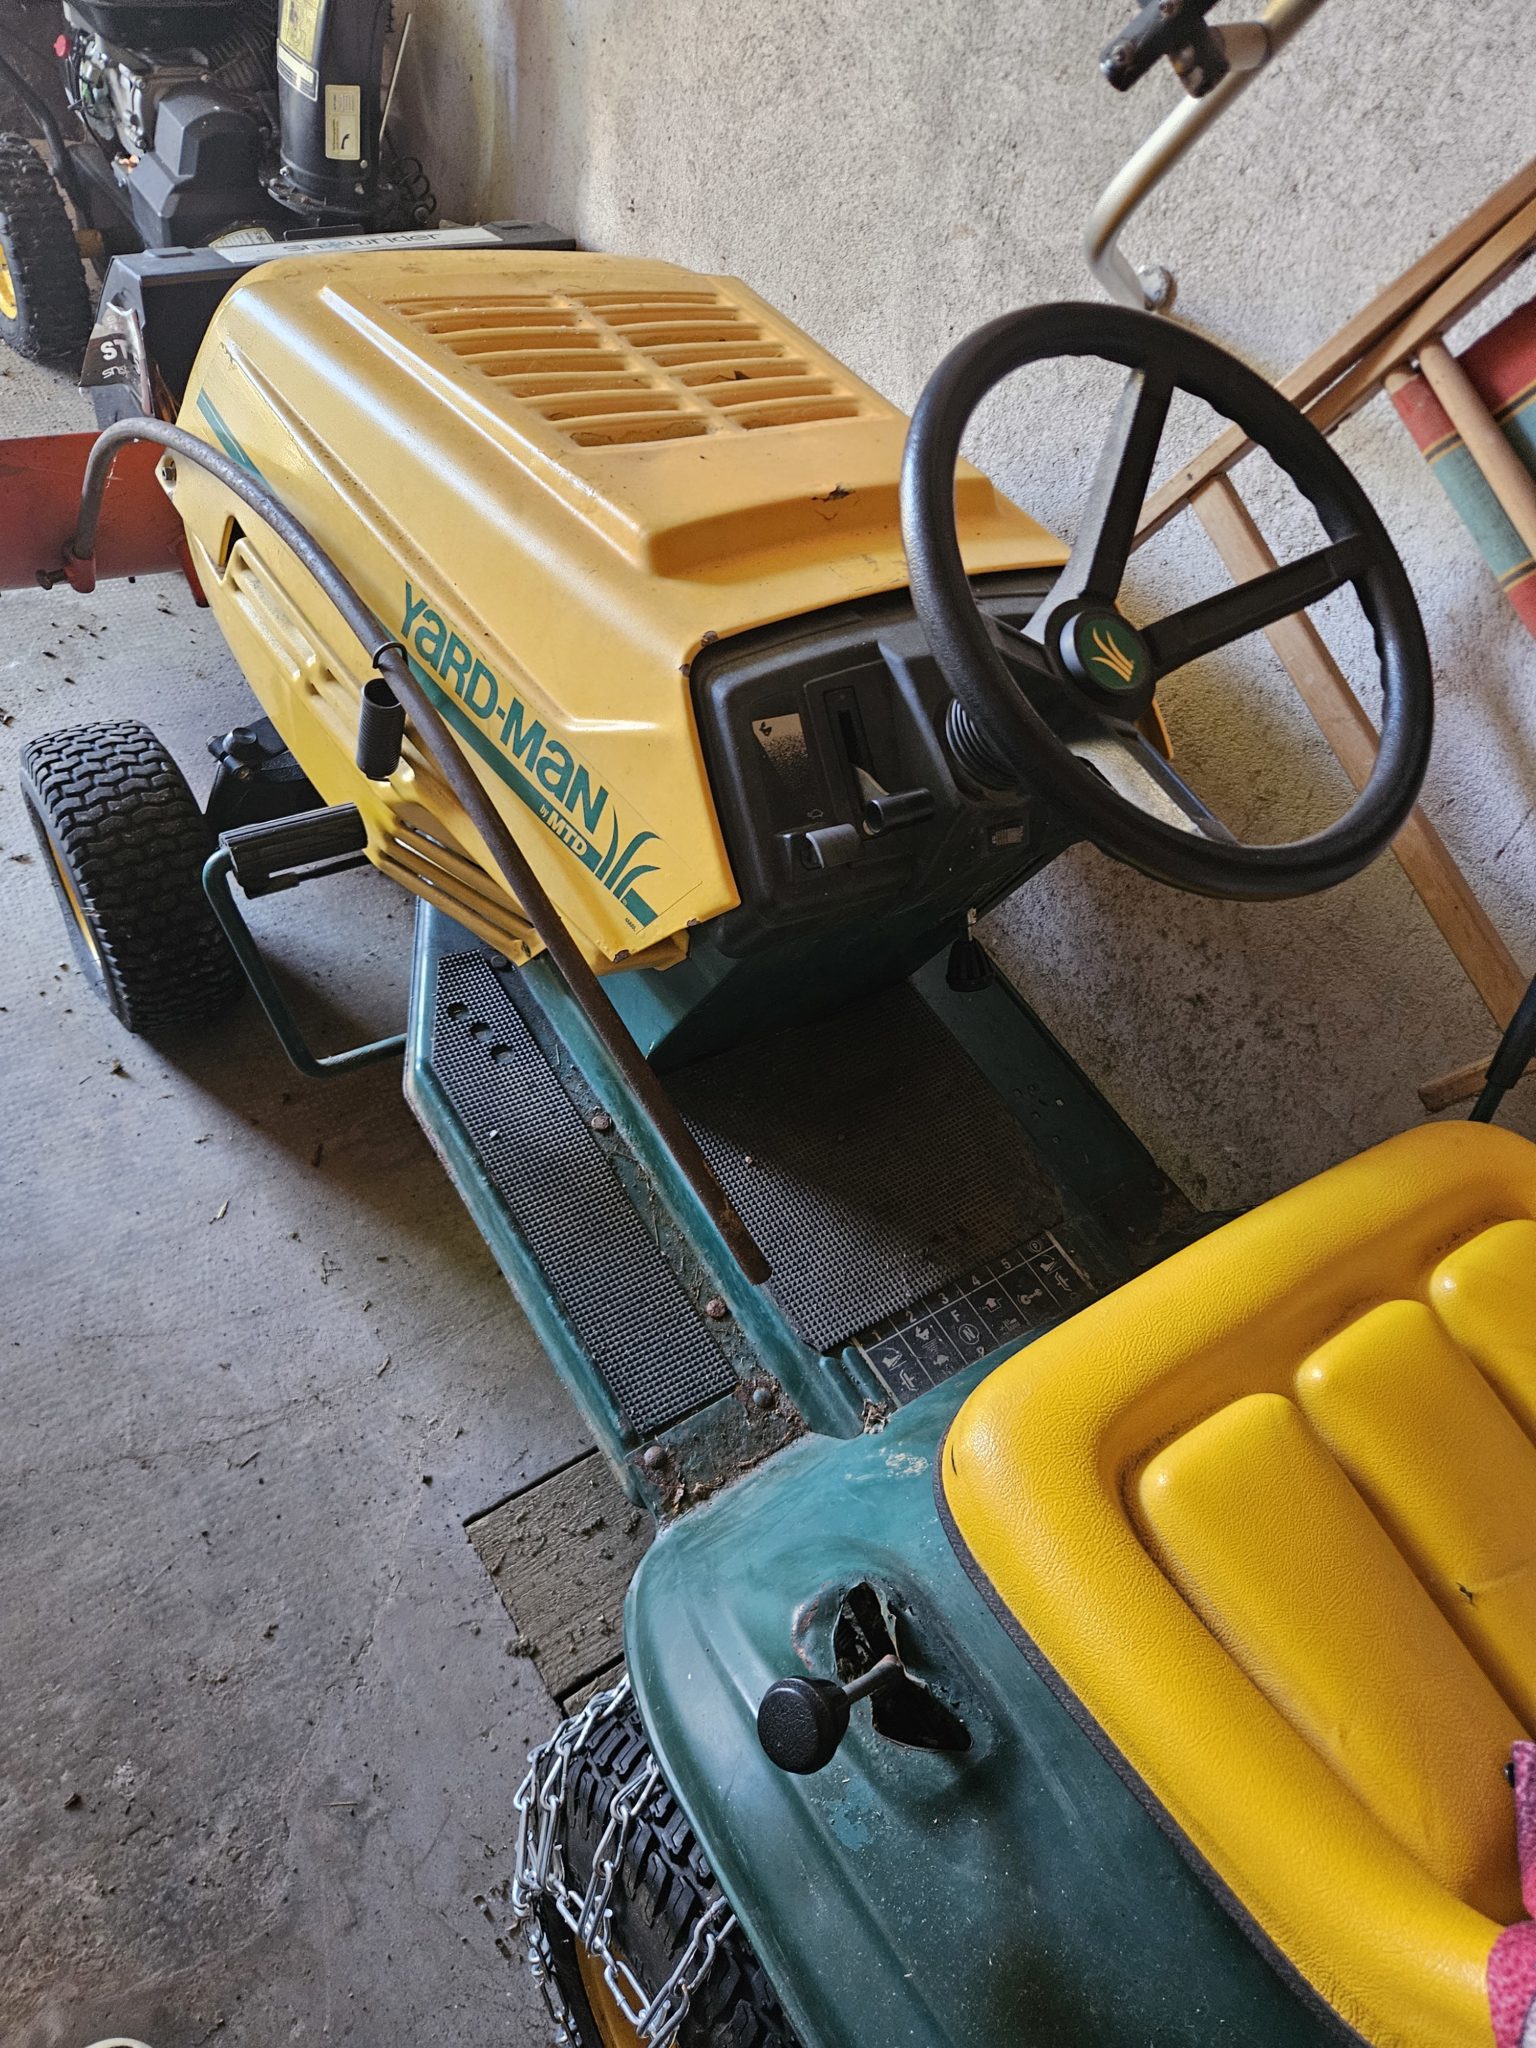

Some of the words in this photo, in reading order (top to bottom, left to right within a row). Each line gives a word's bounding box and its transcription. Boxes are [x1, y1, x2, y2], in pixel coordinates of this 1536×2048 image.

[539, 804, 550, 818] by
[547, 810, 588, 856] MTD
[872, 1330, 882, 1341] 1
[905, 1310, 917, 1323] 2
[938, 1292, 950, 1305] 3
[971, 1275, 982, 1286] 4
[1001, 1258, 1012, 1270] 5
[950, 1309, 961, 1322] F
